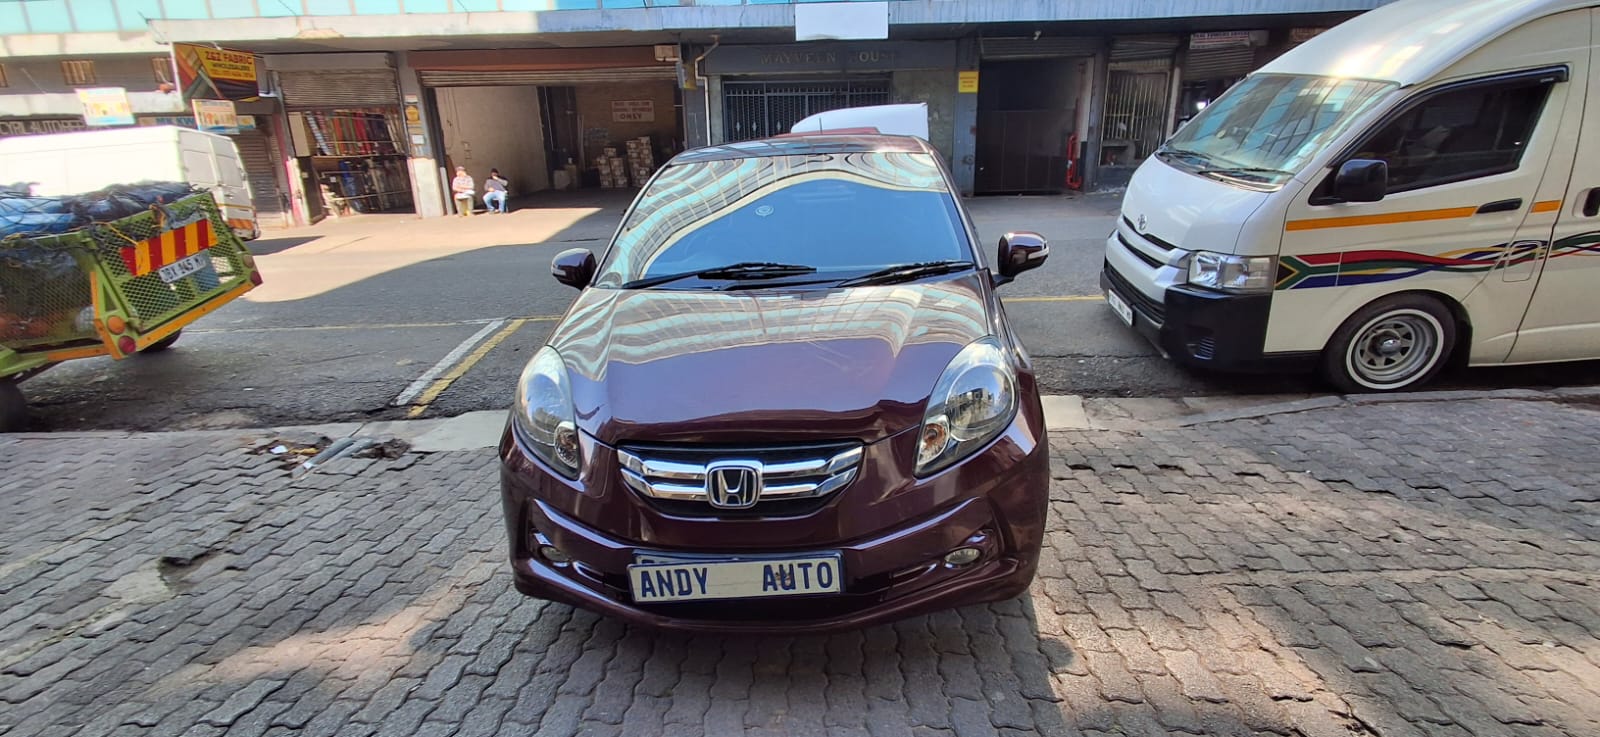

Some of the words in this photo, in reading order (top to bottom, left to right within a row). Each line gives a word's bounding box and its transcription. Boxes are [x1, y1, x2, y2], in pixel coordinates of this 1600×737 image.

[223, 52, 252, 64] FABRIC
[641, 567, 708, 598] ANDY
[762, 562, 833, 592] AUTO
